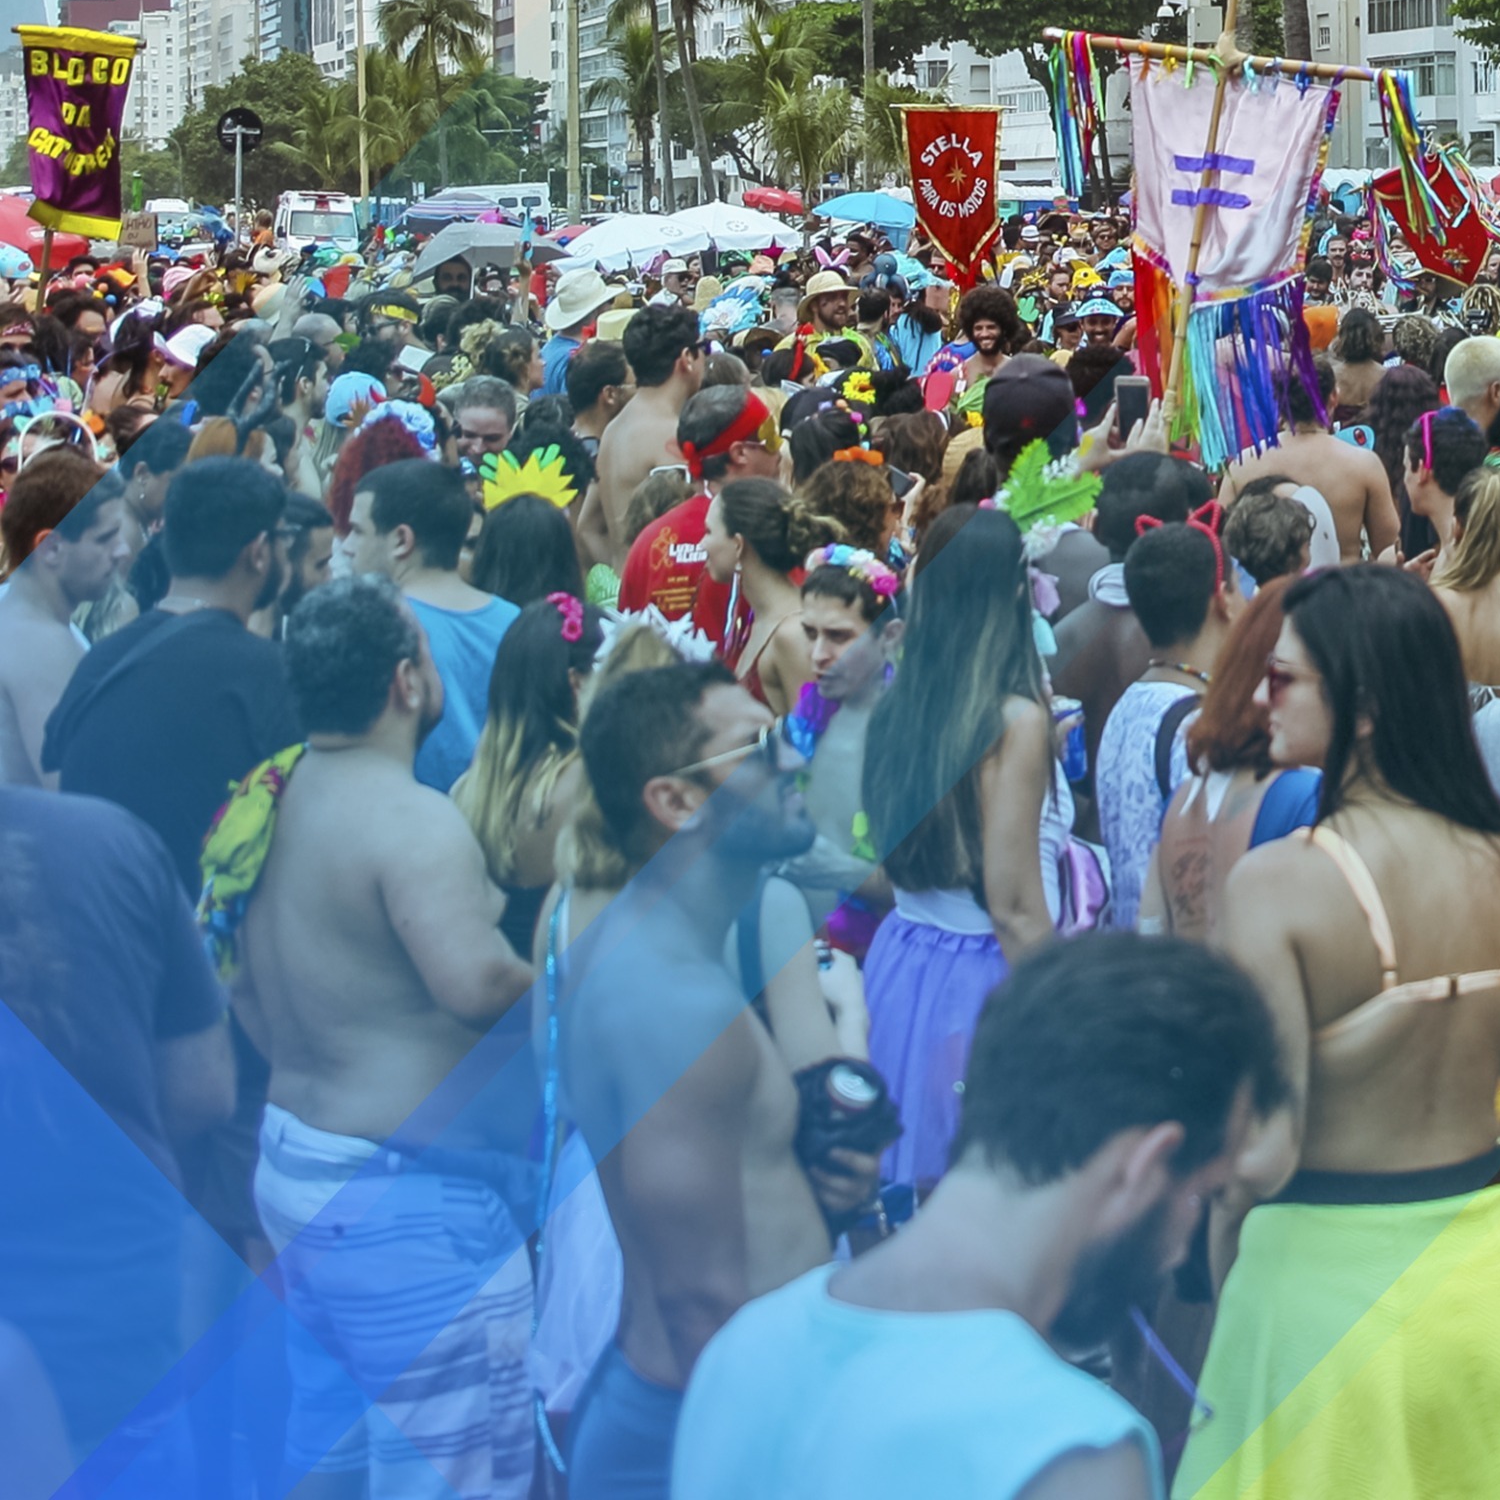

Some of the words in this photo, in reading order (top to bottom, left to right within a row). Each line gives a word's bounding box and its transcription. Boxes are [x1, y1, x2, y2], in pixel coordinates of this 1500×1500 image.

[30, 50, 130, 86] BLOCO
[62, 102, 91, 127] DA
[920, 133, 983, 168] STELLA
[918, 178, 941, 210] PARA
[938, 200, 957, 218] OS
